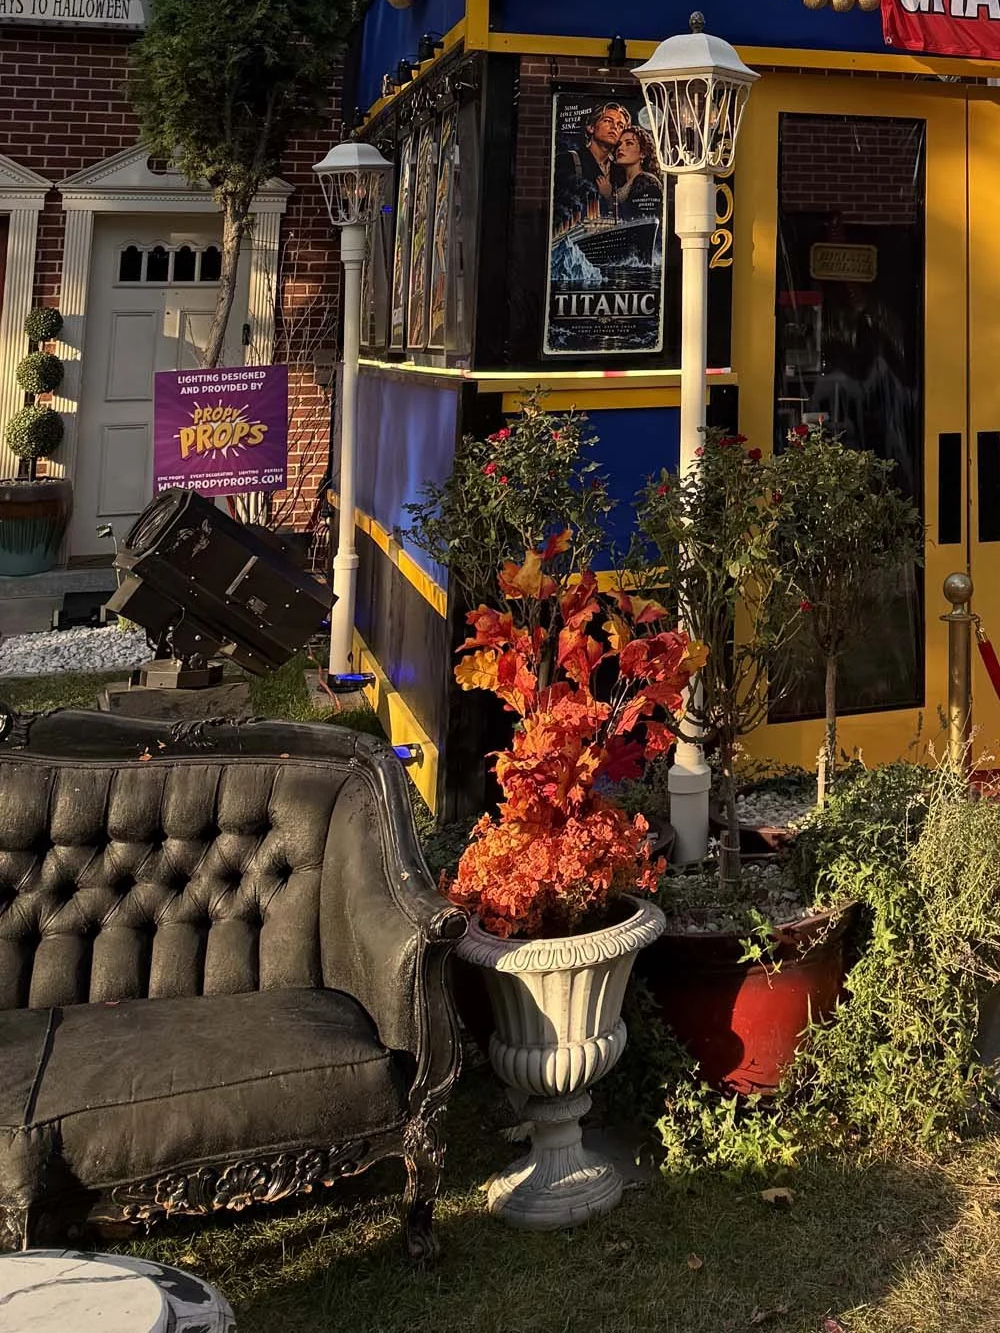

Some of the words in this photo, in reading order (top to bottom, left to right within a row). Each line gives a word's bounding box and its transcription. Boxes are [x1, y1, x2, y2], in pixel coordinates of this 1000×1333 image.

[555, 293, 656, 316] TITANIC
[178, 374, 219, 384] LIGHTING
[222, 371, 266, 381] DESIGNED
[180, 386, 199, 395] AND
[202, 383, 248, 393] PROVIDED
[250, 382, 263, 390] BY
[194, 407, 241, 424] PROPY
[180, 422, 268, 459] PROPS
